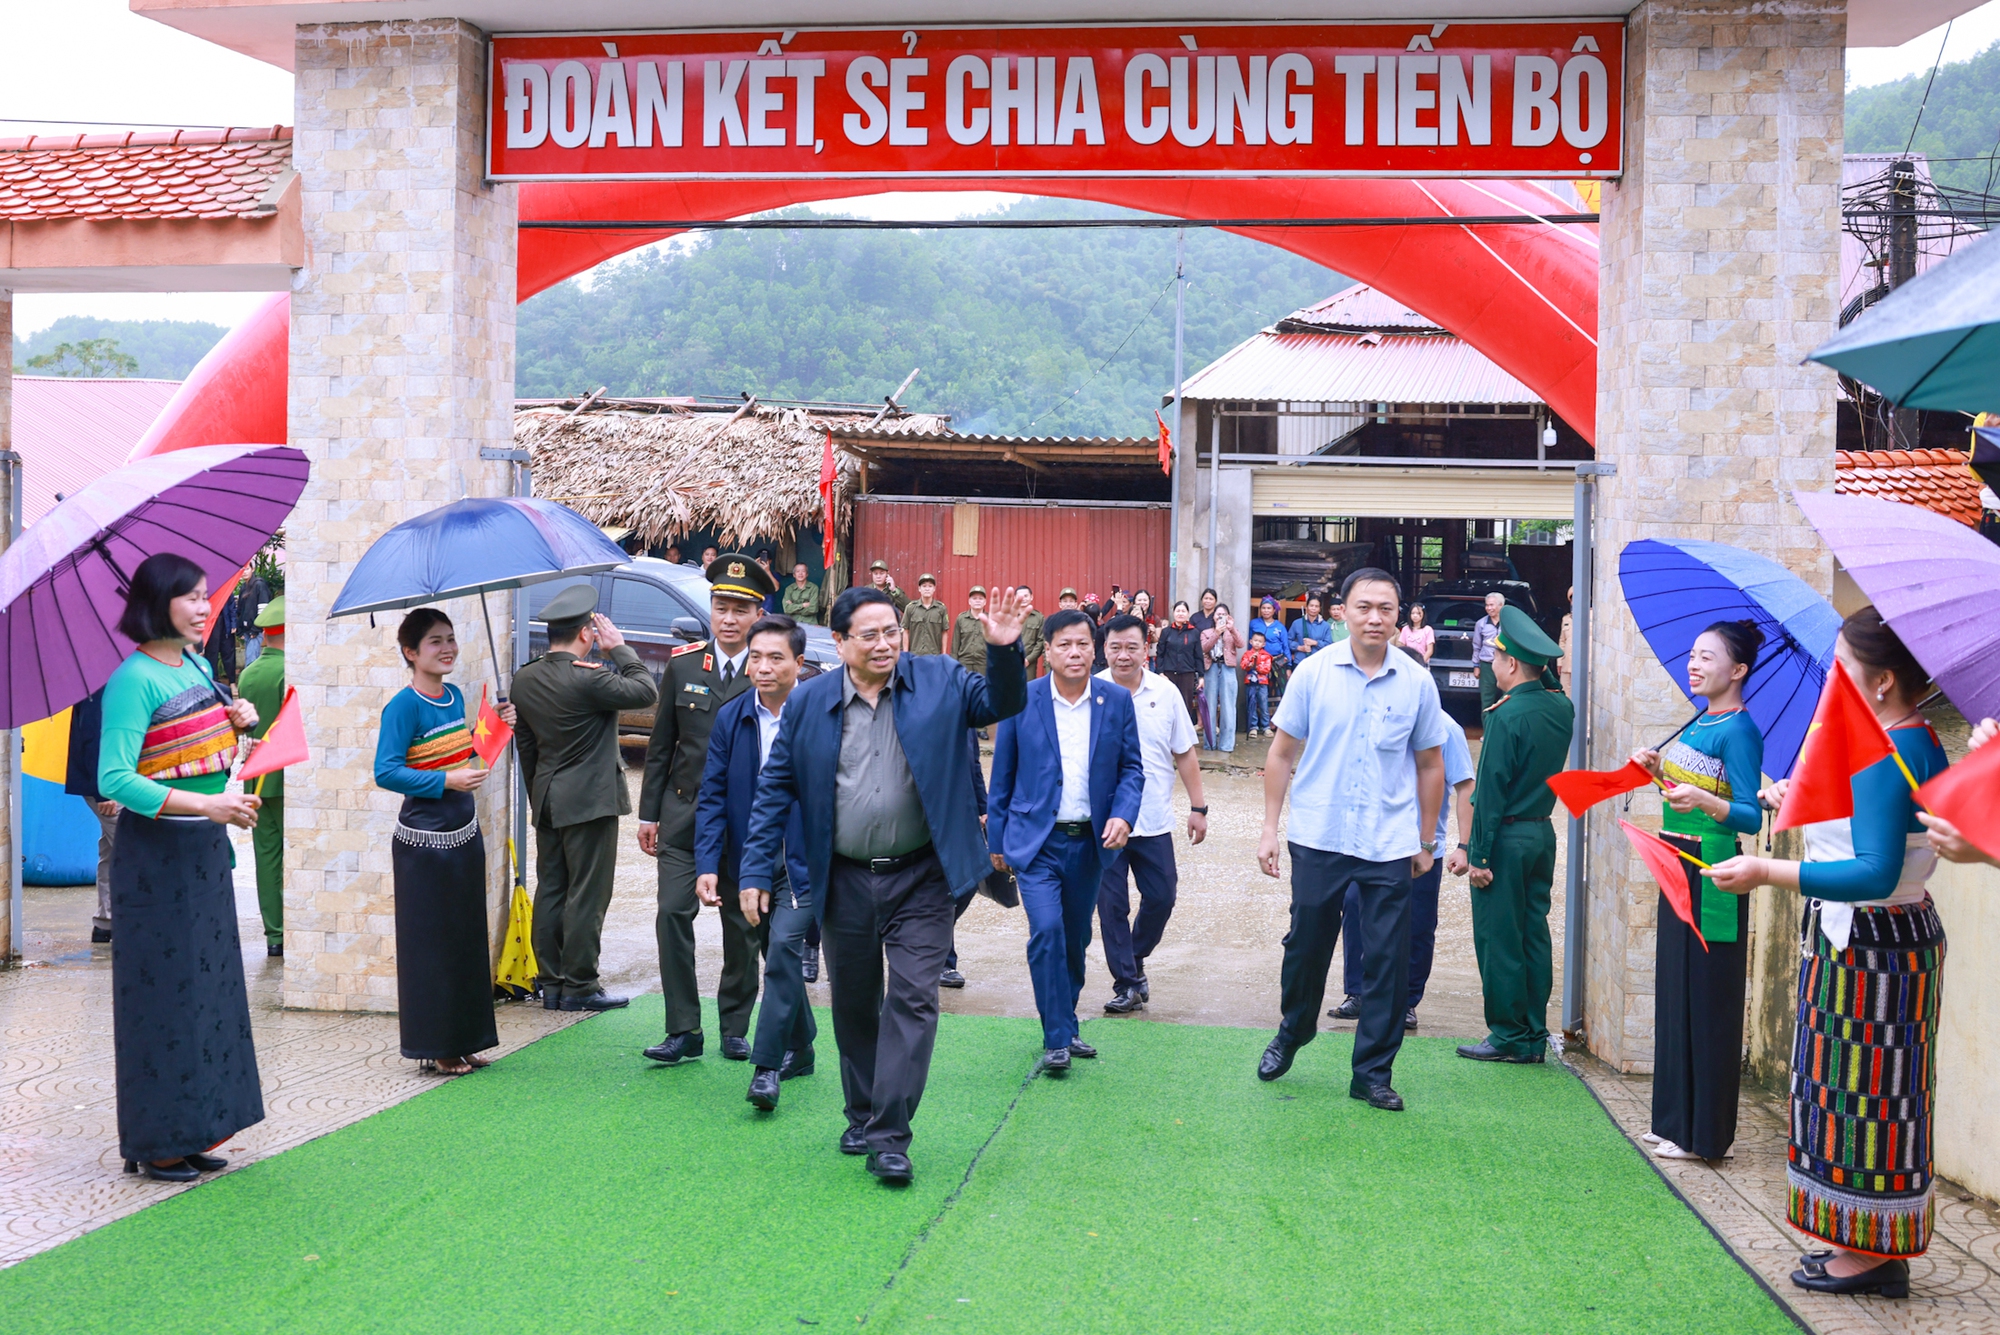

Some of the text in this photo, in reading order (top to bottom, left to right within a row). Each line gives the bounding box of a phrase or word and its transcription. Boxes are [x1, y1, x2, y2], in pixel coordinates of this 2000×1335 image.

[504, 23, 1608, 165] ĐOÀN KẾT, SẺ CHIA CÙNG TIẾN BỘ
